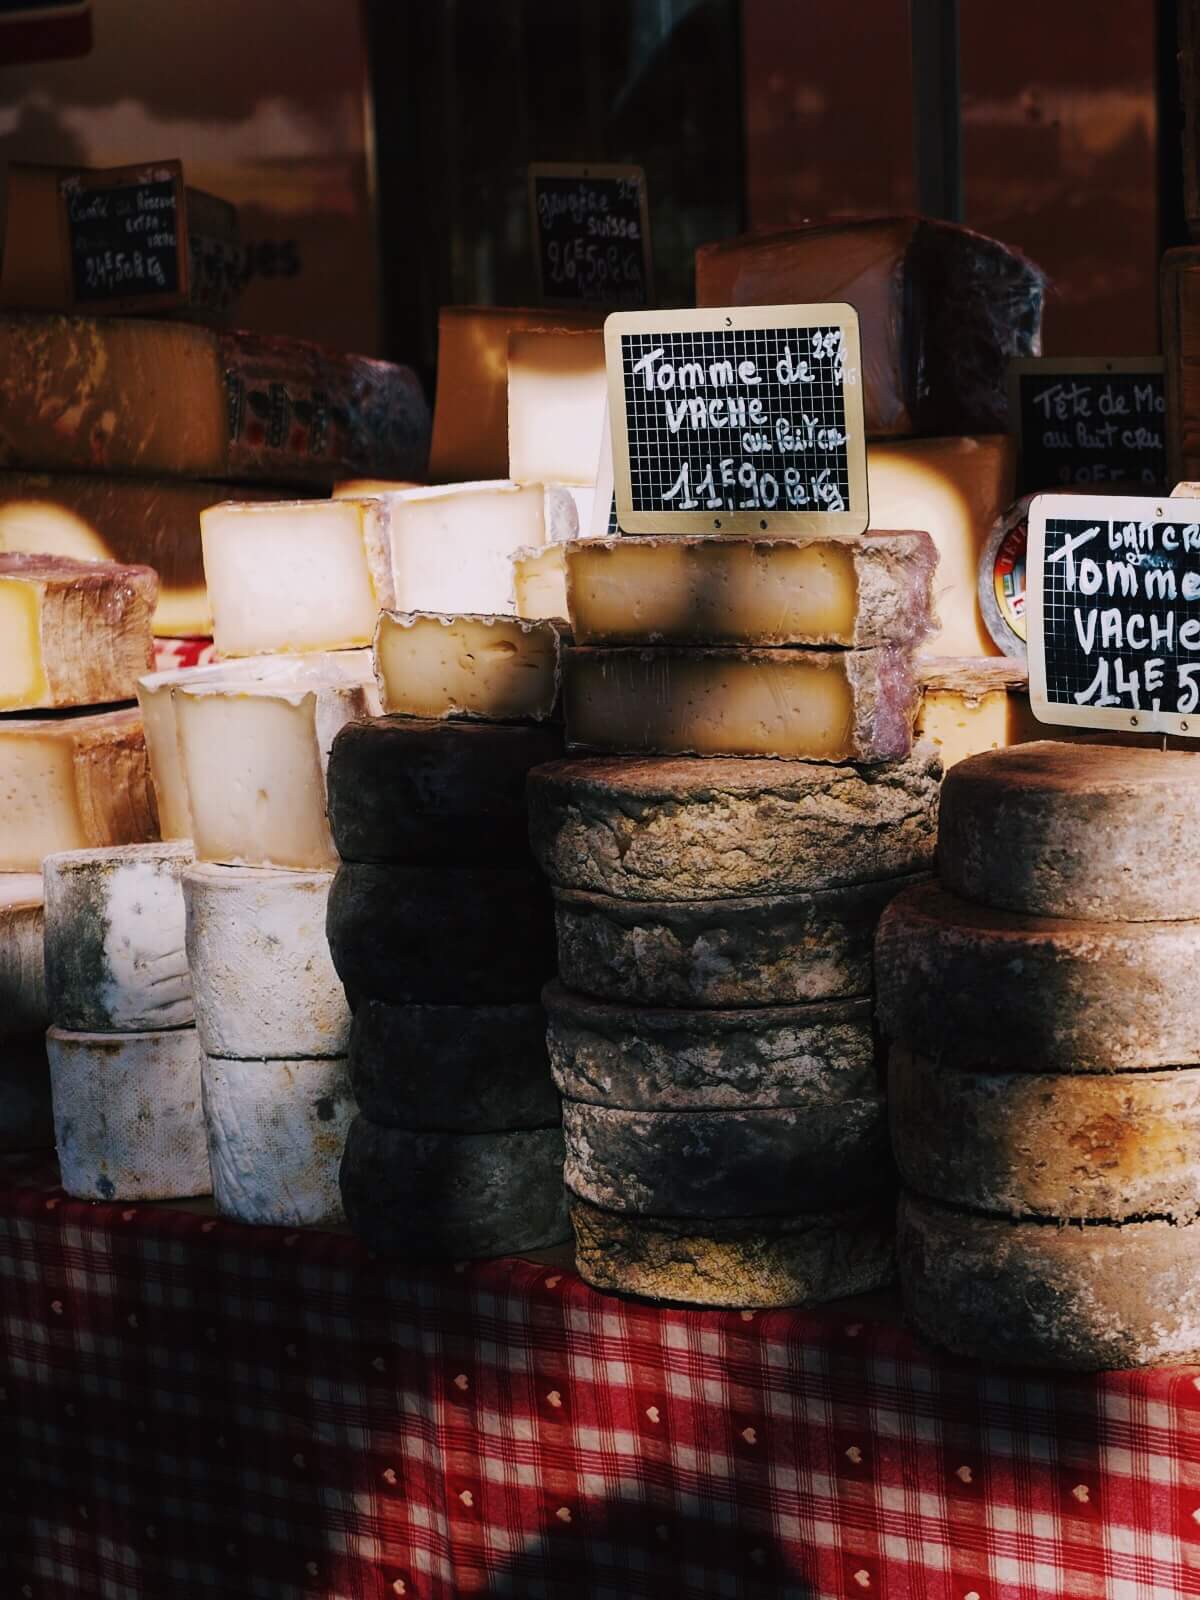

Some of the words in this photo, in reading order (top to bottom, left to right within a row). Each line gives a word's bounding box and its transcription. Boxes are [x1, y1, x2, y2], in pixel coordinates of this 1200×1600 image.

[633, 348, 762, 391] Tomme
[776, 346, 815, 385] de
[1098, 384, 1131, 416] de
[811, 468, 845, 511] Kg
